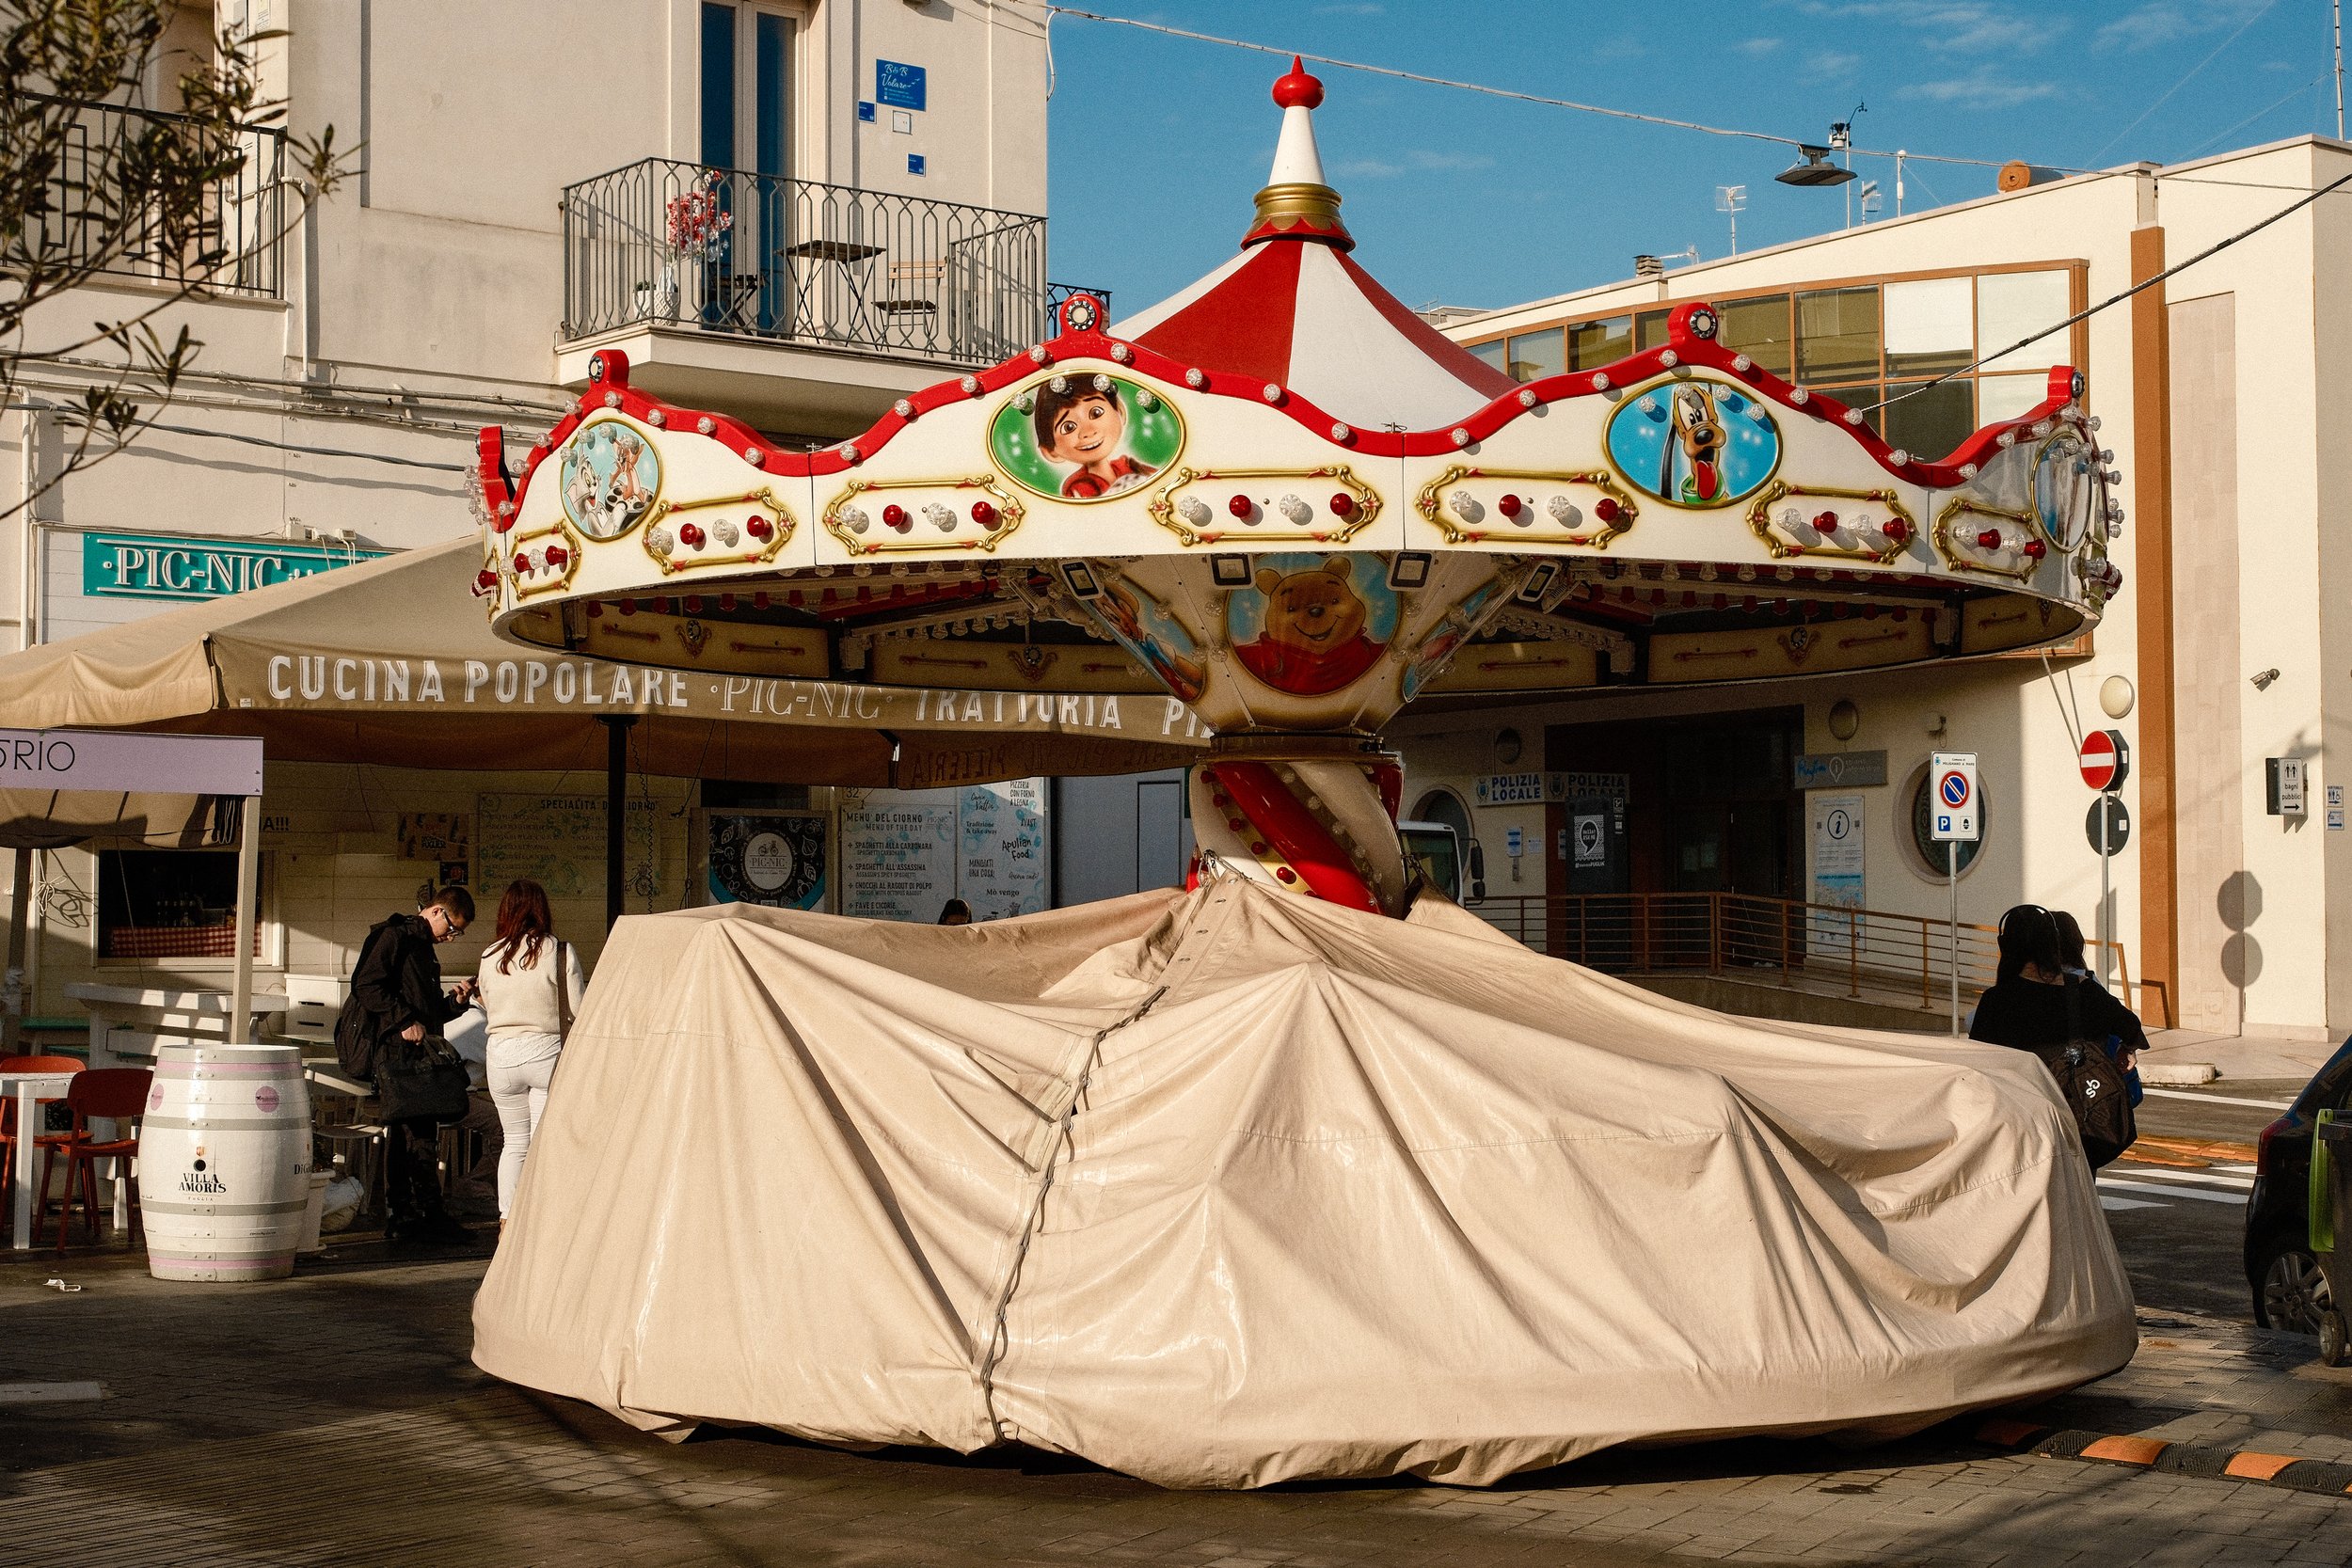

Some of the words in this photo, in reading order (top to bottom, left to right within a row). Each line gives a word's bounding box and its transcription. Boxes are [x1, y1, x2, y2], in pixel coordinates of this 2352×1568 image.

[881, 73, 907, 89] Volare
[268, 656, 445, 703] CUCINA
[464, 660, 689, 707] POPOLARE
[915, 689, 1122, 730] TRATTORIA
[1010, 780, 1030, 789] PIZZERIA
[1491, 773, 1541, 788] POLIZIA
[1567, 773, 1626, 787] POLIZIA
[1009, 789, 1020, 798] CON
[1021, 790, 1035, 799] FORNO
[1491, 786, 1541, 801] LOCALE
[875, 813, 891, 823] DEL
[893, 814, 923, 823] GIORNO
[1002, 838, 1032, 852] Apulian
[1011, 848, 1030, 861] Food
[751, 857, 786, 867] PIC-NIC
[183, 1173, 220, 1184] VILLA
[178, 1181, 227, 1194] AMORIS
